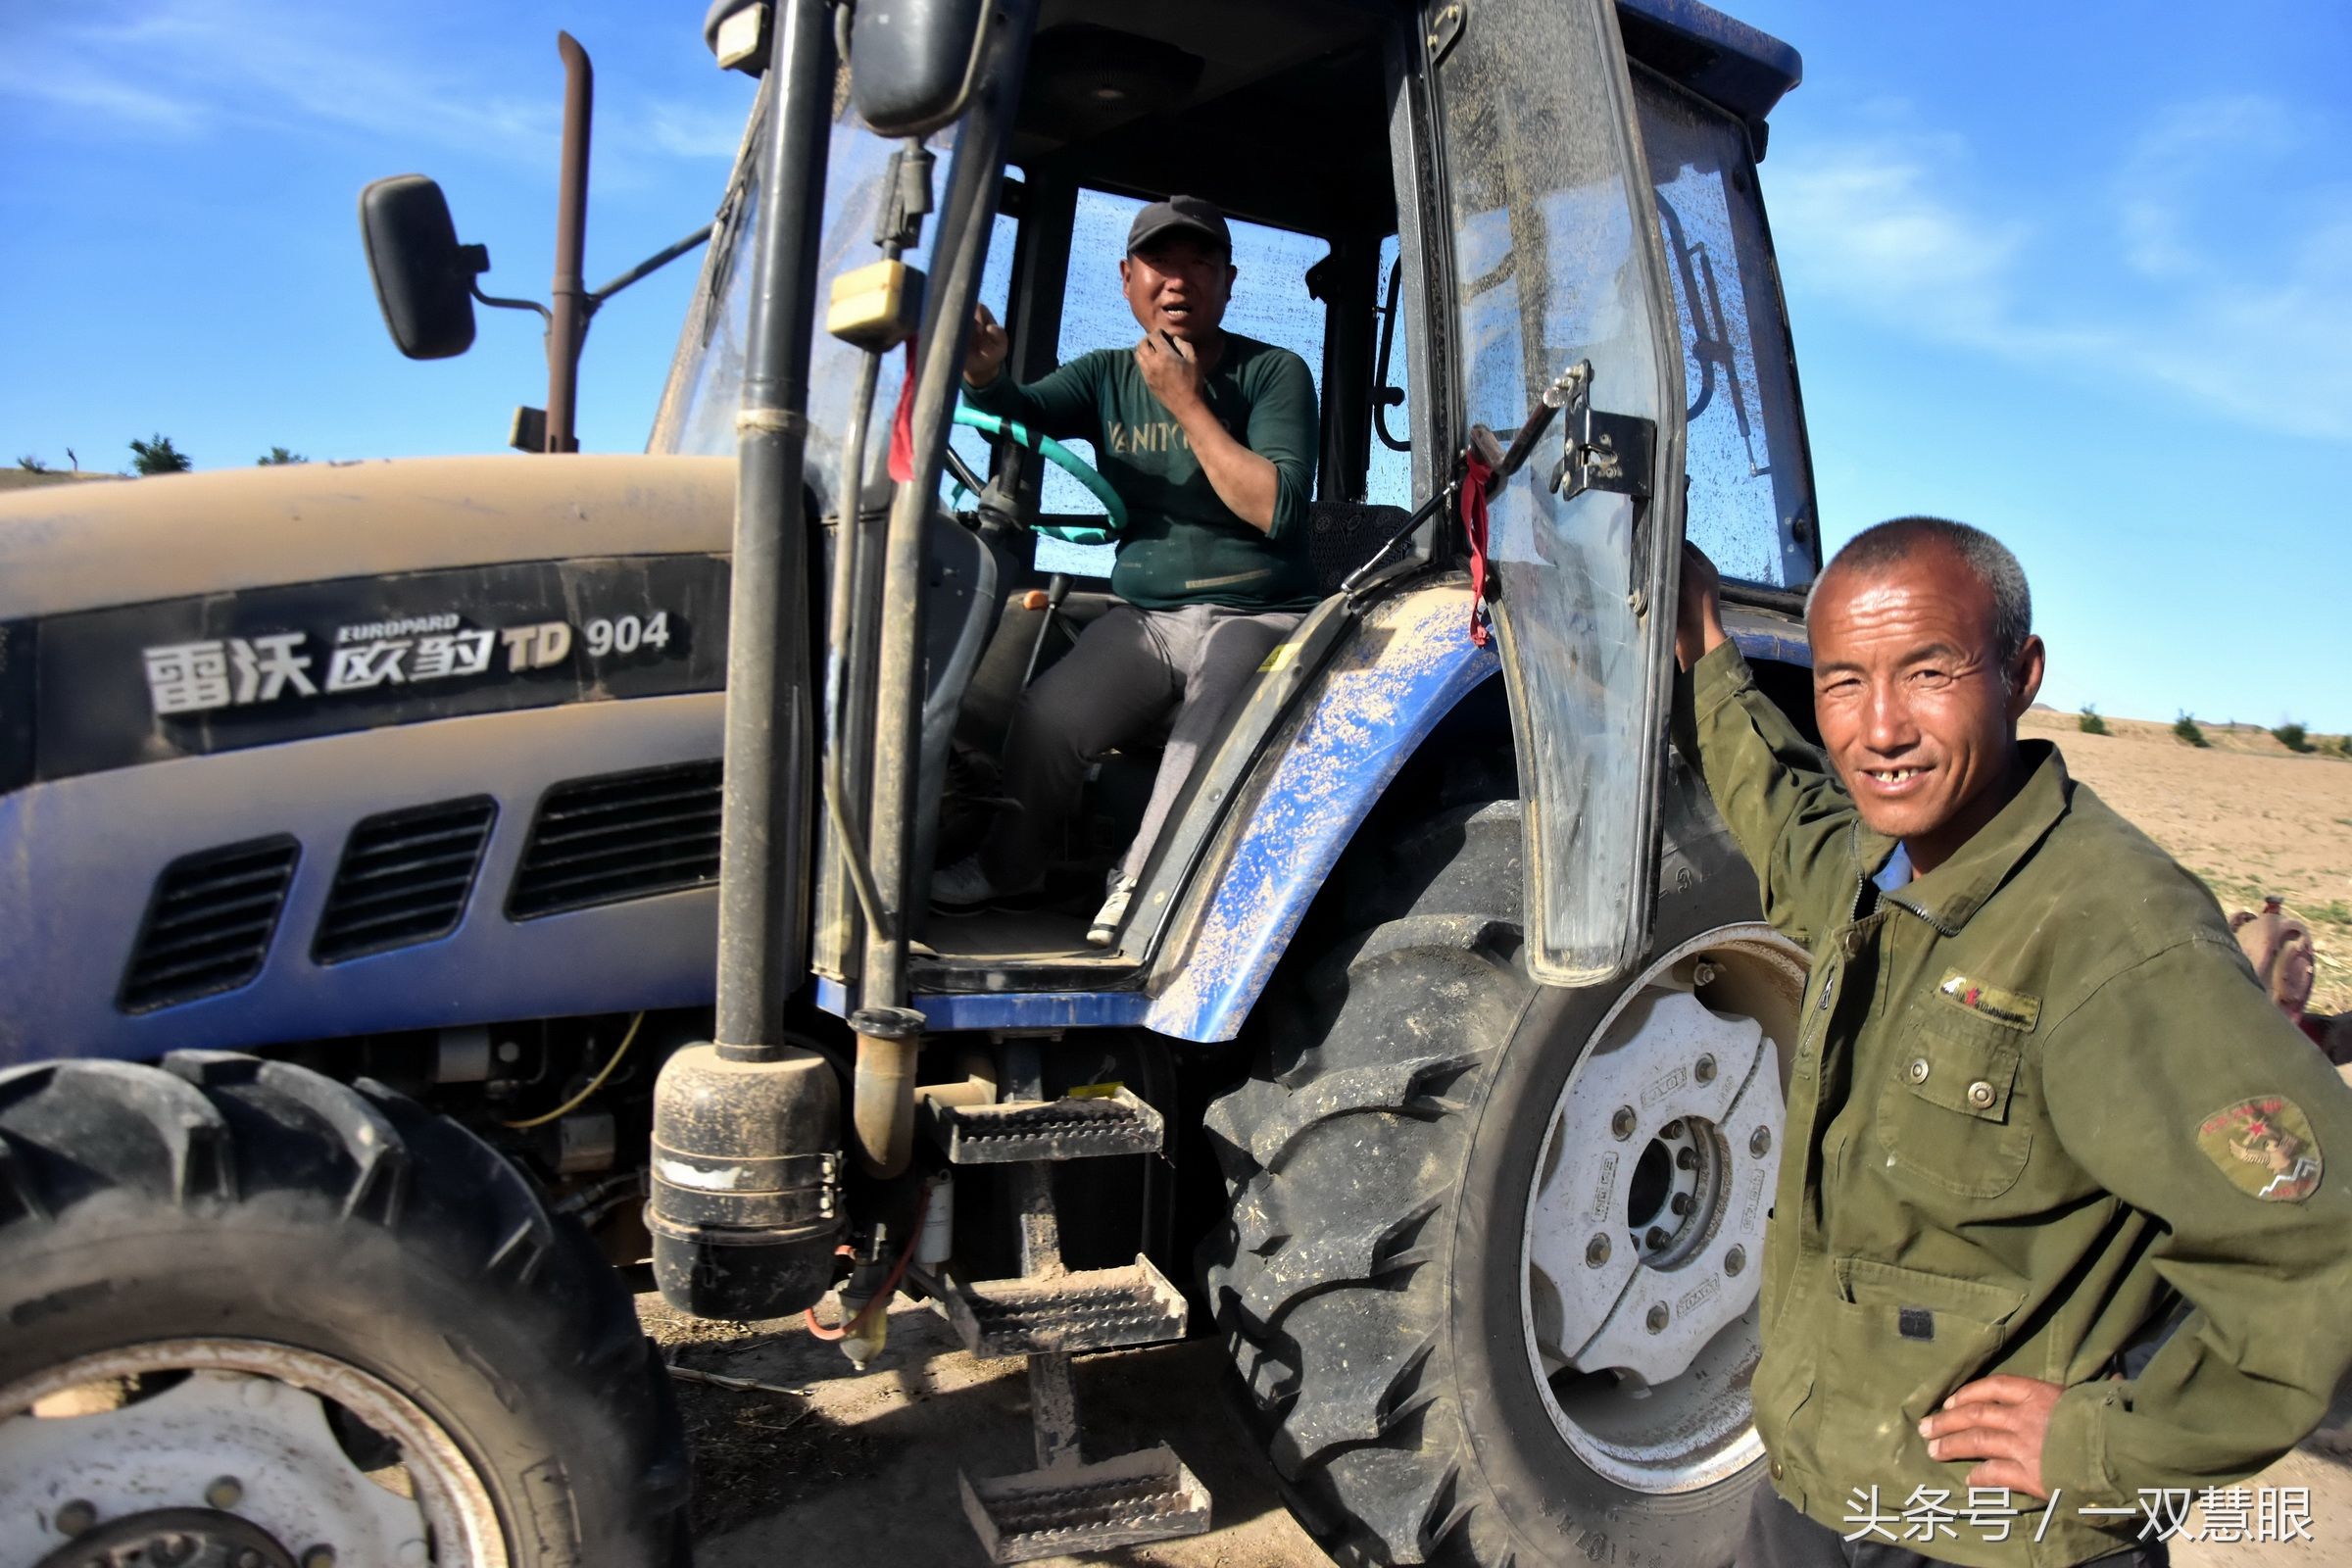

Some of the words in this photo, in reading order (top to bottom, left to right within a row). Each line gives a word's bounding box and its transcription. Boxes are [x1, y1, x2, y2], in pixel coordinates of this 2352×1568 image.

[338, 613, 461, 643] EUROPARD
[502, 621, 572, 673] TD
[587, 611, 670, 658] 904
